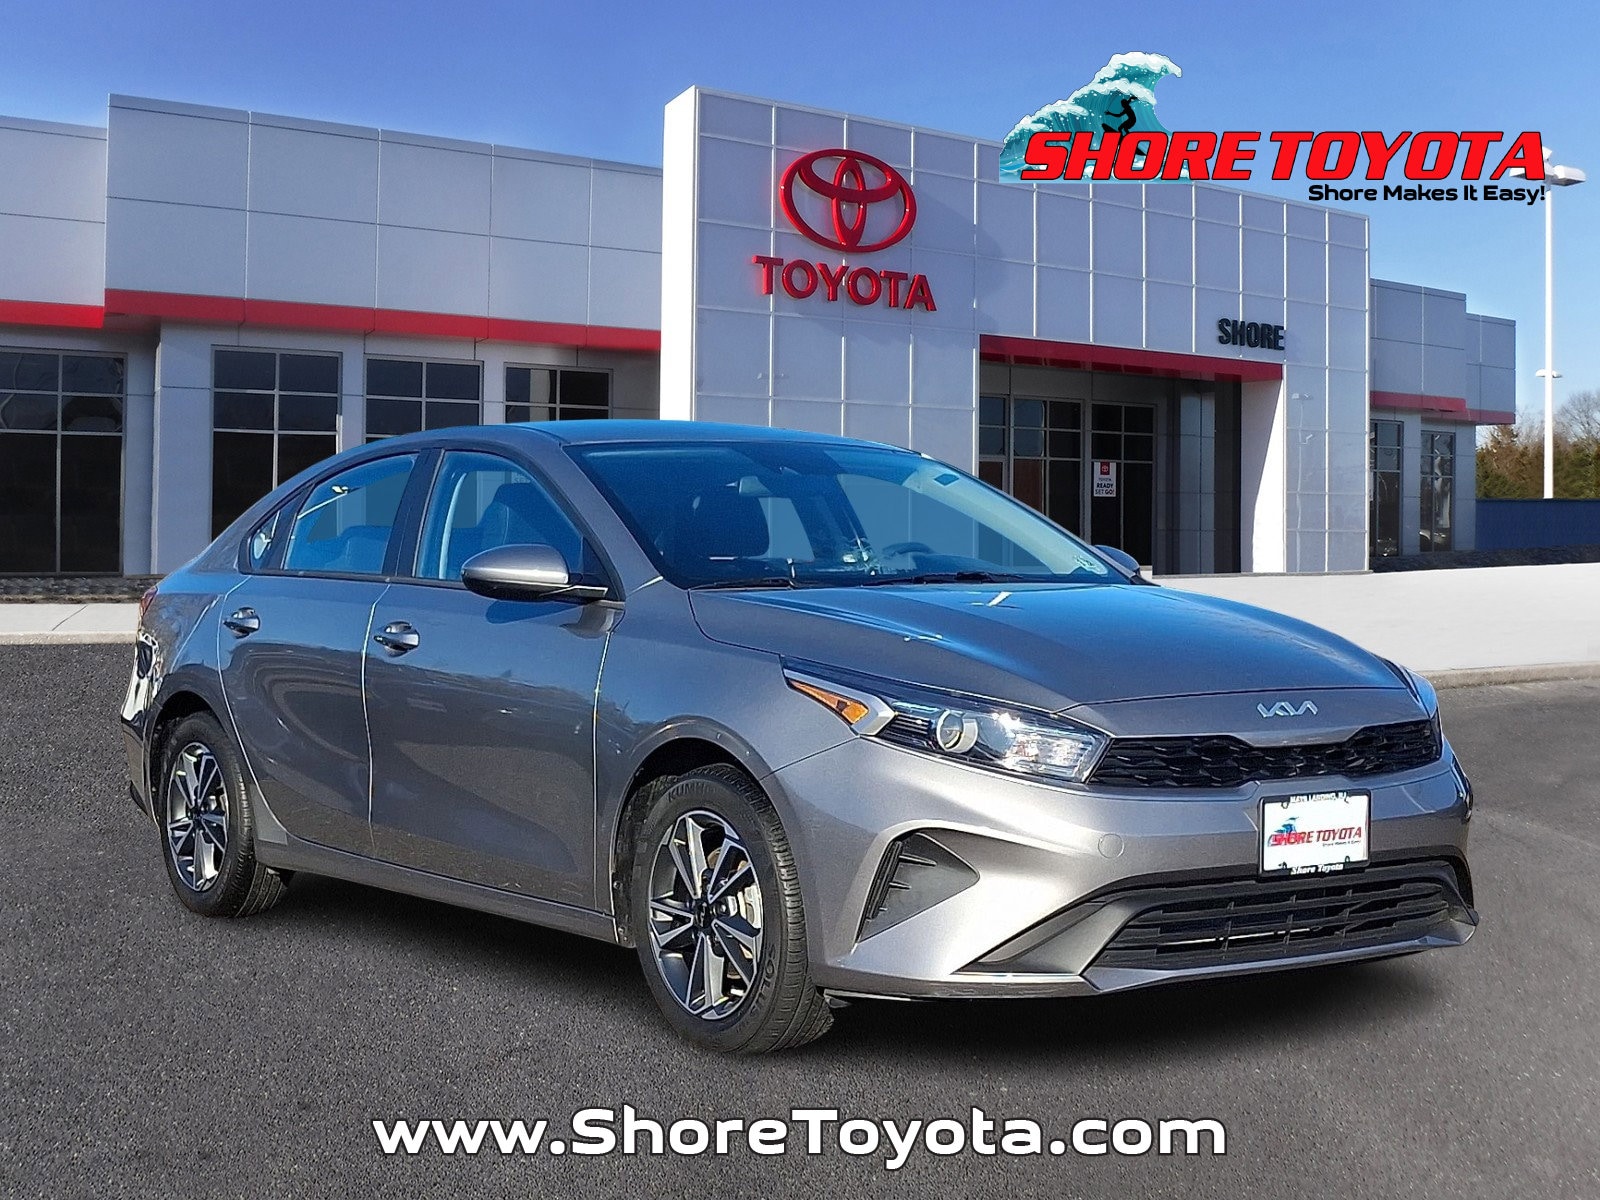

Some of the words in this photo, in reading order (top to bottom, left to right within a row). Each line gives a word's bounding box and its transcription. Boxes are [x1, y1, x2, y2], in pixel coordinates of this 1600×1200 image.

[752, 255, 937, 312] TOYOTA
[1218, 317, 1285, 351] SHORE
[1257, 700, 1318, 718] KIA
[1270, 830, 1315, 847] SHORE
[1316, 826, 1362, 843] TOYOTA
[1290, 865, 1316, 876] Shore
[1317, 863, 1344, 874] Toyota
